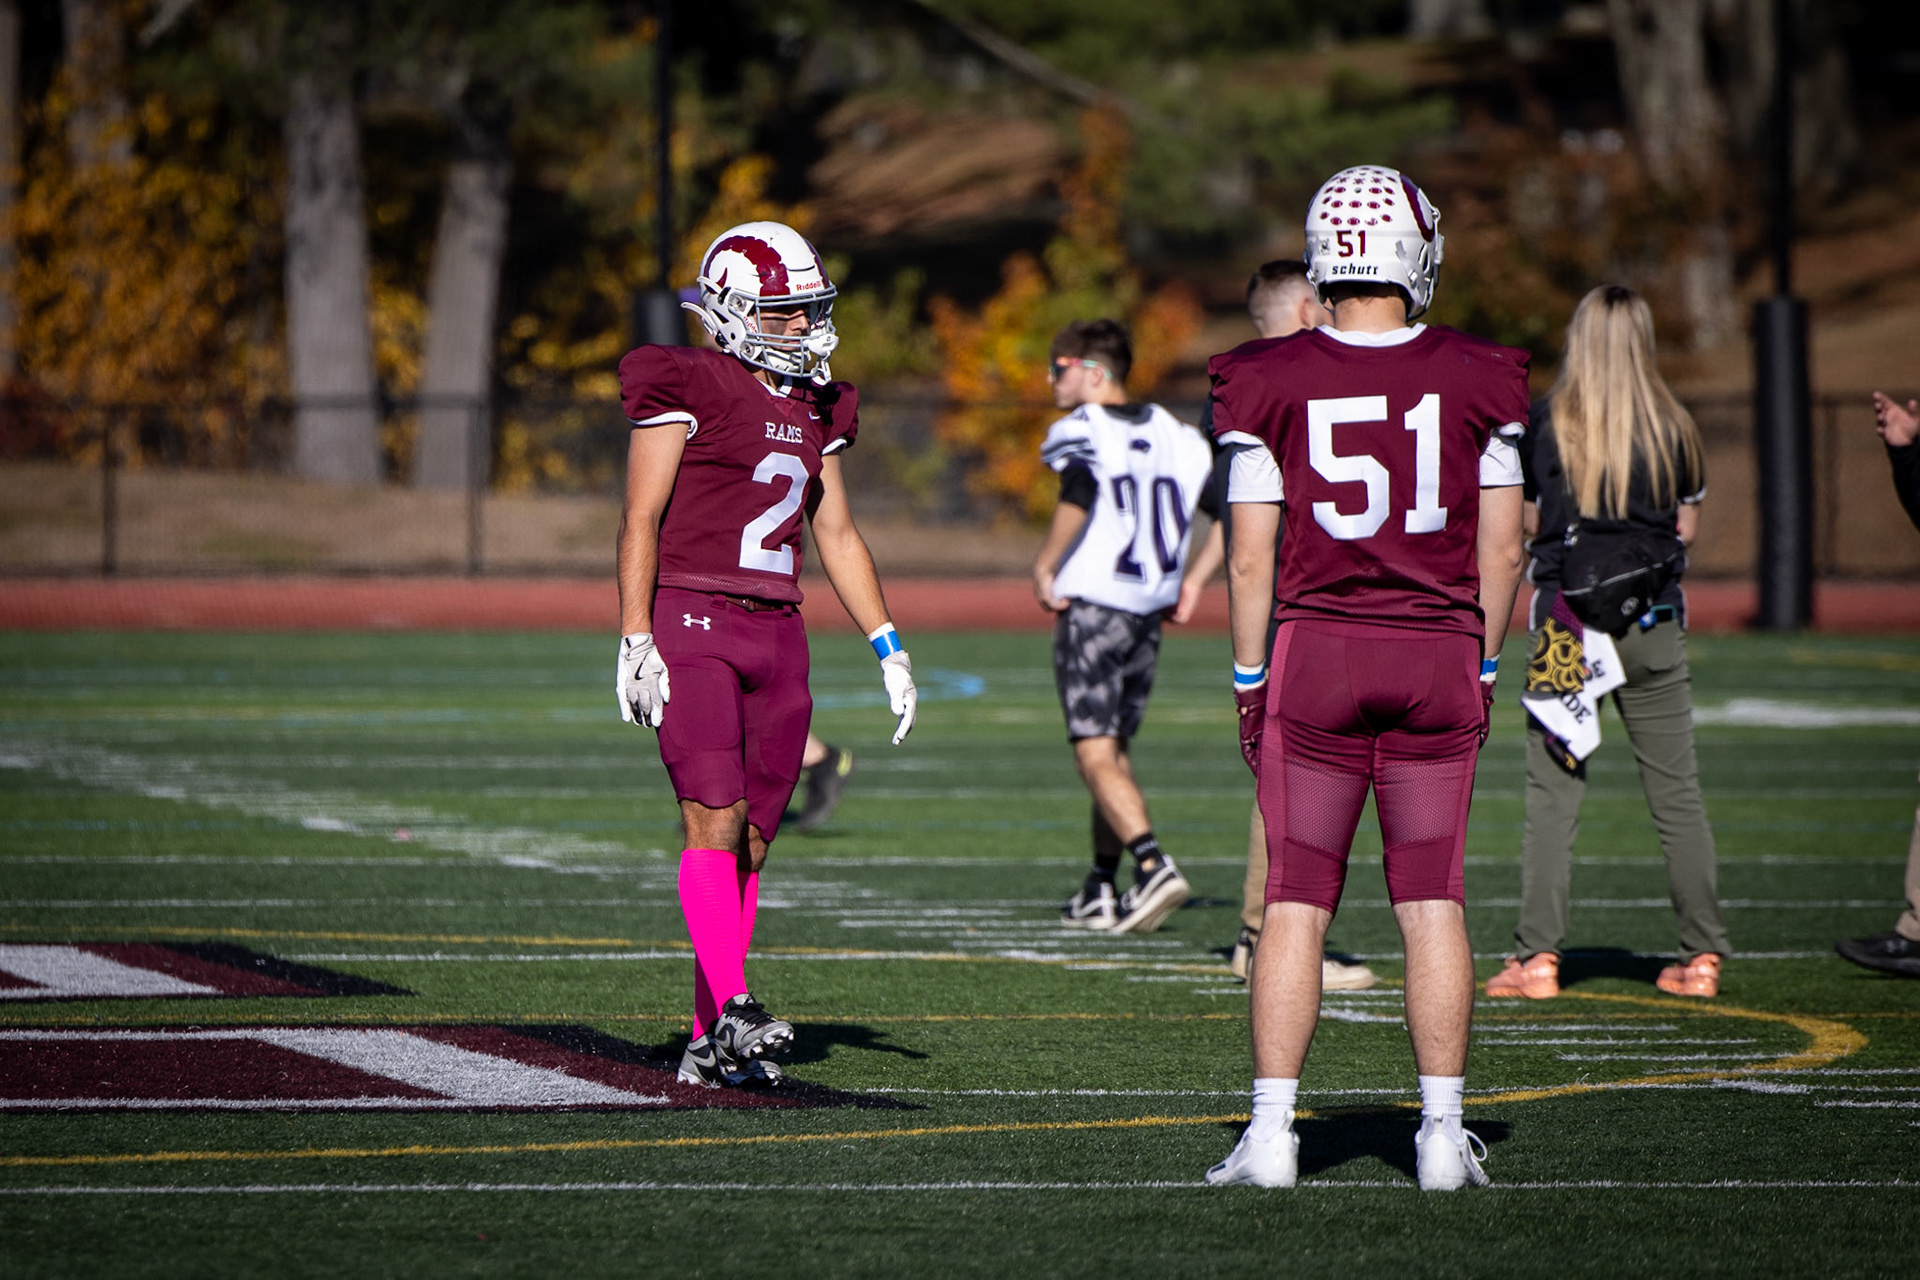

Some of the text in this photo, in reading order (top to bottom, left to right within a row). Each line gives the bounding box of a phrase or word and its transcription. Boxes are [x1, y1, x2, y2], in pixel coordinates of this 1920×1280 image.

[1336, 230, 1366, 258] 51
[796, 280, 821, 291] Riddell
[765, 422, 803, 444] RAMS
[1307, 393, 1448, 541] 51
[739, 451, 810, 576] 2
[1110, 474, 1190, 584] 20
